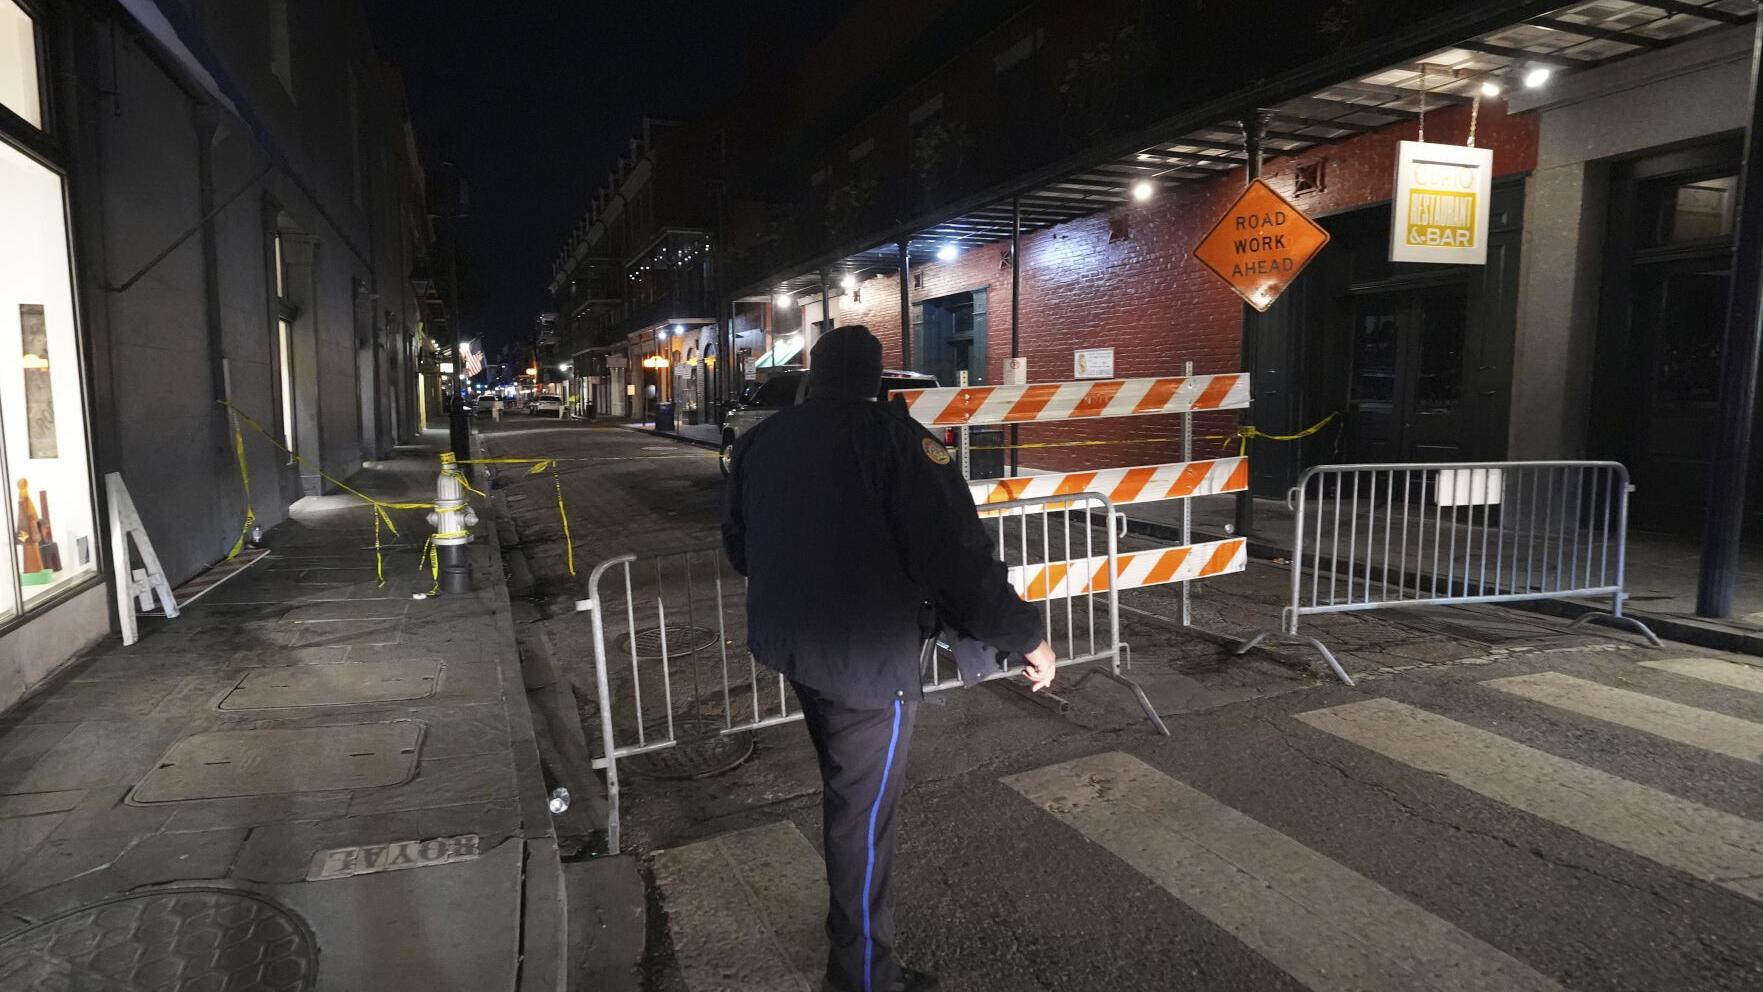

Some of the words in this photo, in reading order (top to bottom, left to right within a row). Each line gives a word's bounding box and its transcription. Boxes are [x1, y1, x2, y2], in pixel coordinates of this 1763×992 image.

[1411, 193, 1473, 227] RESTAURANT
[1235, 211, 1286, 230] ROAD
[1234, 234, 1285, 254] WORK
[1232, 257, 1294, 277] AHEAD
[329, 836, 477, 871] ROYAL
